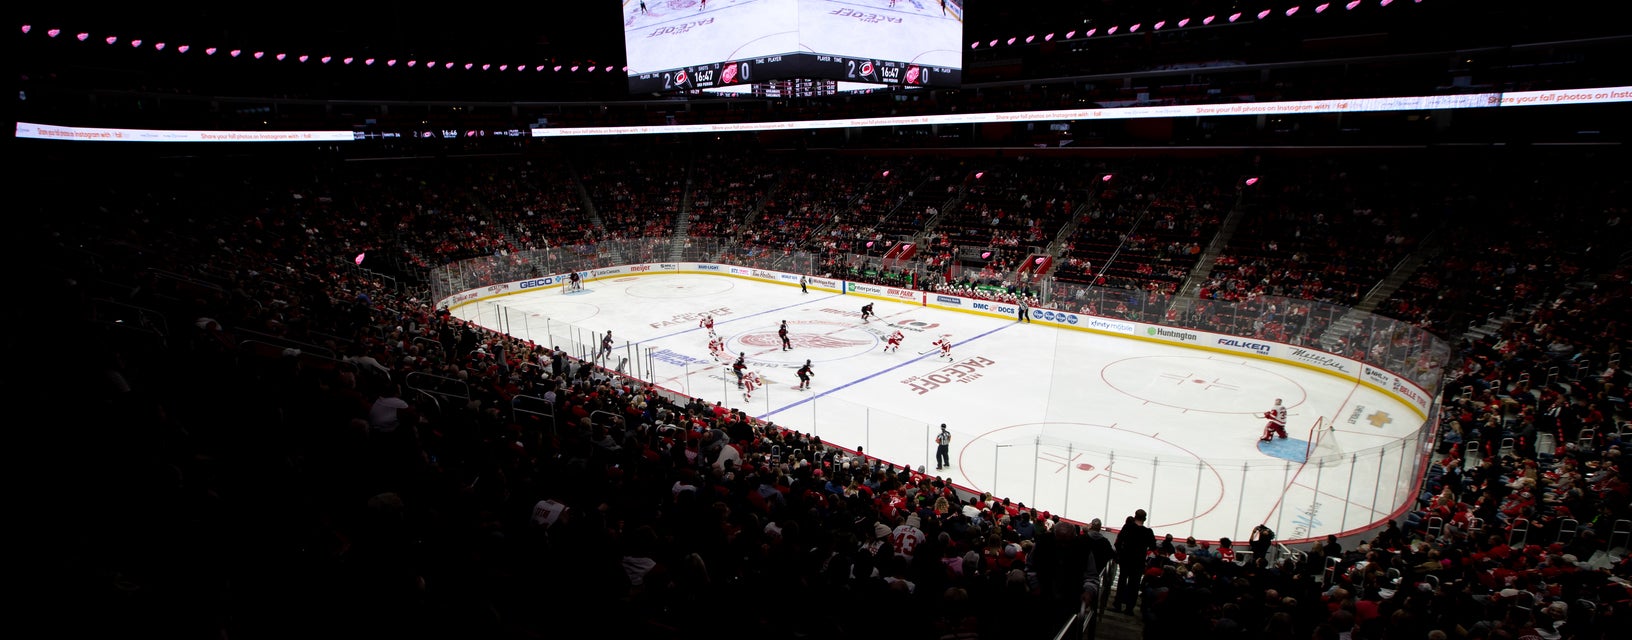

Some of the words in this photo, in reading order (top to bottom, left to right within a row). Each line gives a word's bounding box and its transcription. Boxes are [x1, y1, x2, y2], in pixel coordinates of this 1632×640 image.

[741, 63, 749, 80] 0
[848, 60, 855, 78] 2
[881, 66, 898, 78] 16:47
[922, 68, 928, 83] 0
[664, 74, 671, 89] 2
[695, 71, 713, 82] 16:47
[1516, 96, 1537, 104] your
[1556, 92, 1592, 102] photos
[520, 278, 552, 288] GEICO
[1091, 320, 1110, 329] xfinity
[1111, 322, 1132, 331] mobile
[1157, 328, 1197, 340] Huntington
[1218, 338, 1271, 351] FALKEN
[1400, 385, 1416, 400] BELLE
[894, 533, 917, 556] 43
